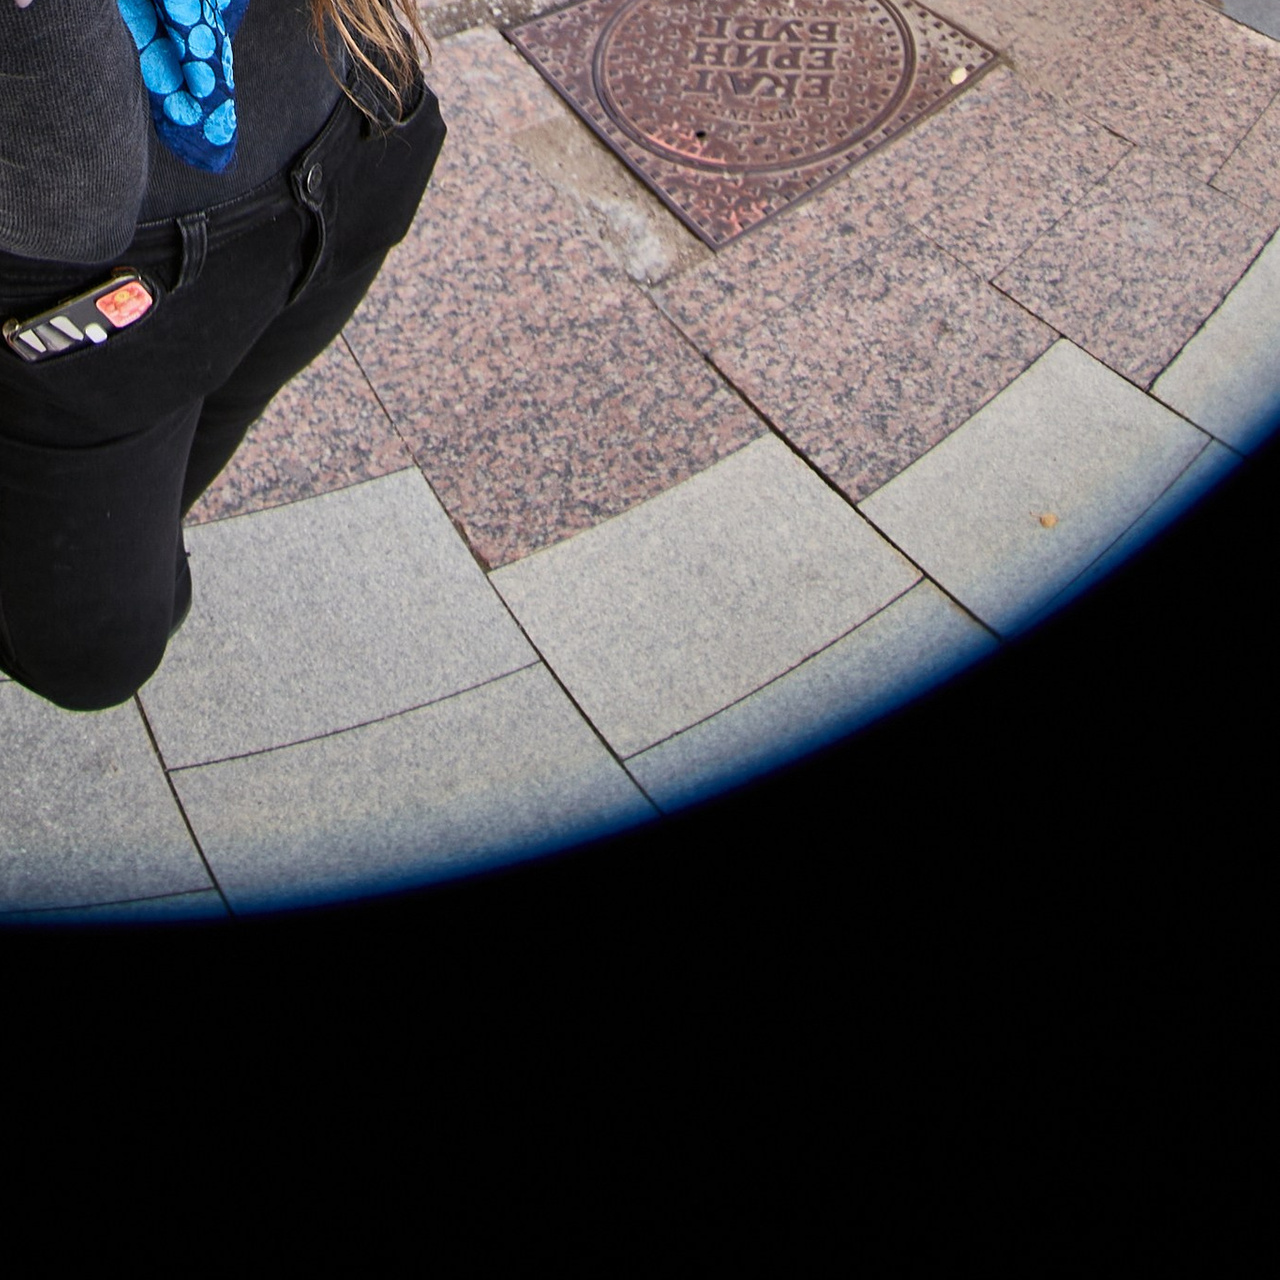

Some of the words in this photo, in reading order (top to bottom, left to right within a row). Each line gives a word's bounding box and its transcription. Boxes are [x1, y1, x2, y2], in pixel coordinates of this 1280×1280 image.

[698, 17, 838, 40] БУРГ
[691, 42, 837, 70] ЕРИН
[681, 71, 834, 98] ЕКАТ
